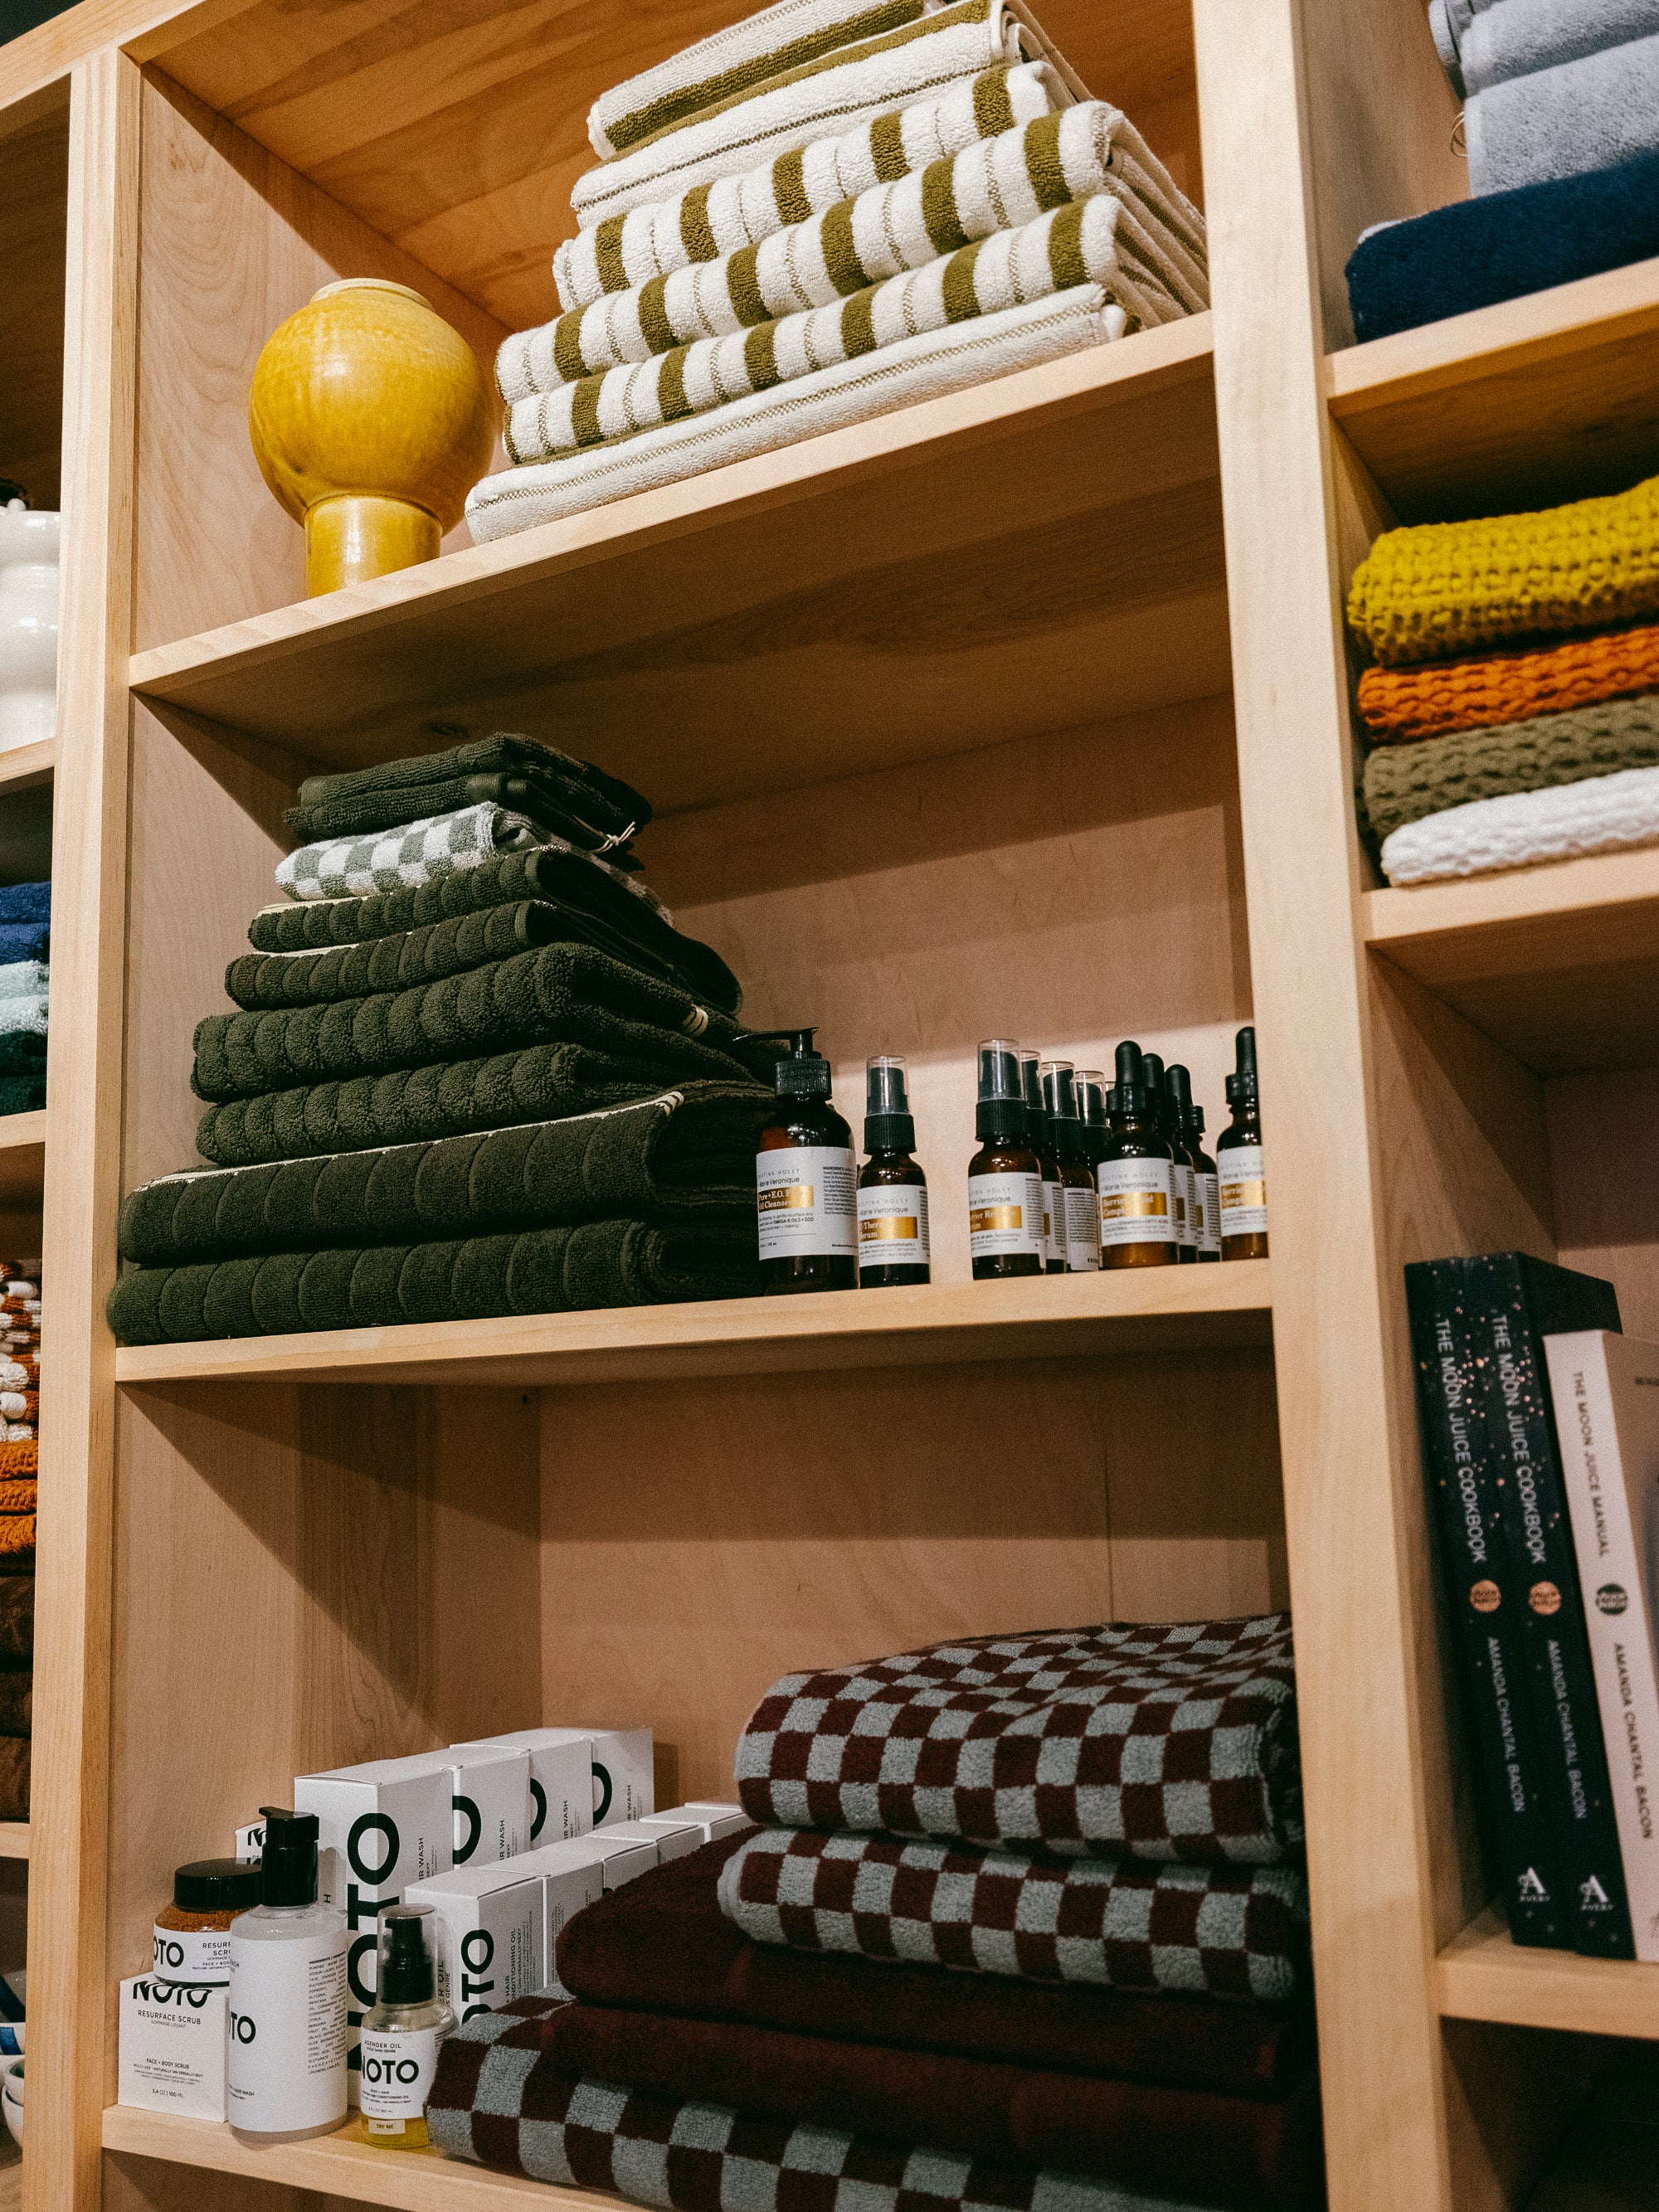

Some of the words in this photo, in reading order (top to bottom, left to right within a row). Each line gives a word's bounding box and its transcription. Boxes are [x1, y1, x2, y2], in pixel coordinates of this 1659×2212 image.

[769, 1177, 800, 1186] Veronique
[1435, 1320, 1453, 1354] THE
[1492, 1315, 1511, 1350] THE
[1441, 1357, 1462, 1409] MOON
[1498, 1353, 1520, 1407] MOON
[1573, 1370, 1586, 1398] THE
[1449, 1412, 1472, 1464] JUICE
[1506, 1410, 1530, 1461] JUICE
[1578, 1402, 1593, 1446] MOON
[1584, 1451, 1601, 1492] JUICE
[1457, 1466, 1487, 1563] COOKBOOK
[1516, 1465, 1547, 1564] COOKBOOK
[1591, 1495, 1611, 1558] MANUAL
[1488, 1636, 1507, 1696] AMANDA
[1547, 1640, 1568, 1700] AMANDA
[1614, 1642, 1632, 1707] AMANDA
[1496, 1698, 1516, 1761] CHANTAL
[1556, 1702, 1577, 1766] CHANTAL
[1623, 1711, 1644, 1780] CHANTAL
[1506, 1762, 1526, 1813] BACON
[1567, 1768, 1588, 1819] BACON
[1633, 1786, 1653, 1840] BACON
[153, 1935, 184, 1967] OTO
[133, 1981, 213, 2008] NOTO
[138, 2010, 176, 2022] RESURFACE
[178, 2015, 201, 2025] SCRUB
[230, 2011, 256, 2044] TO
